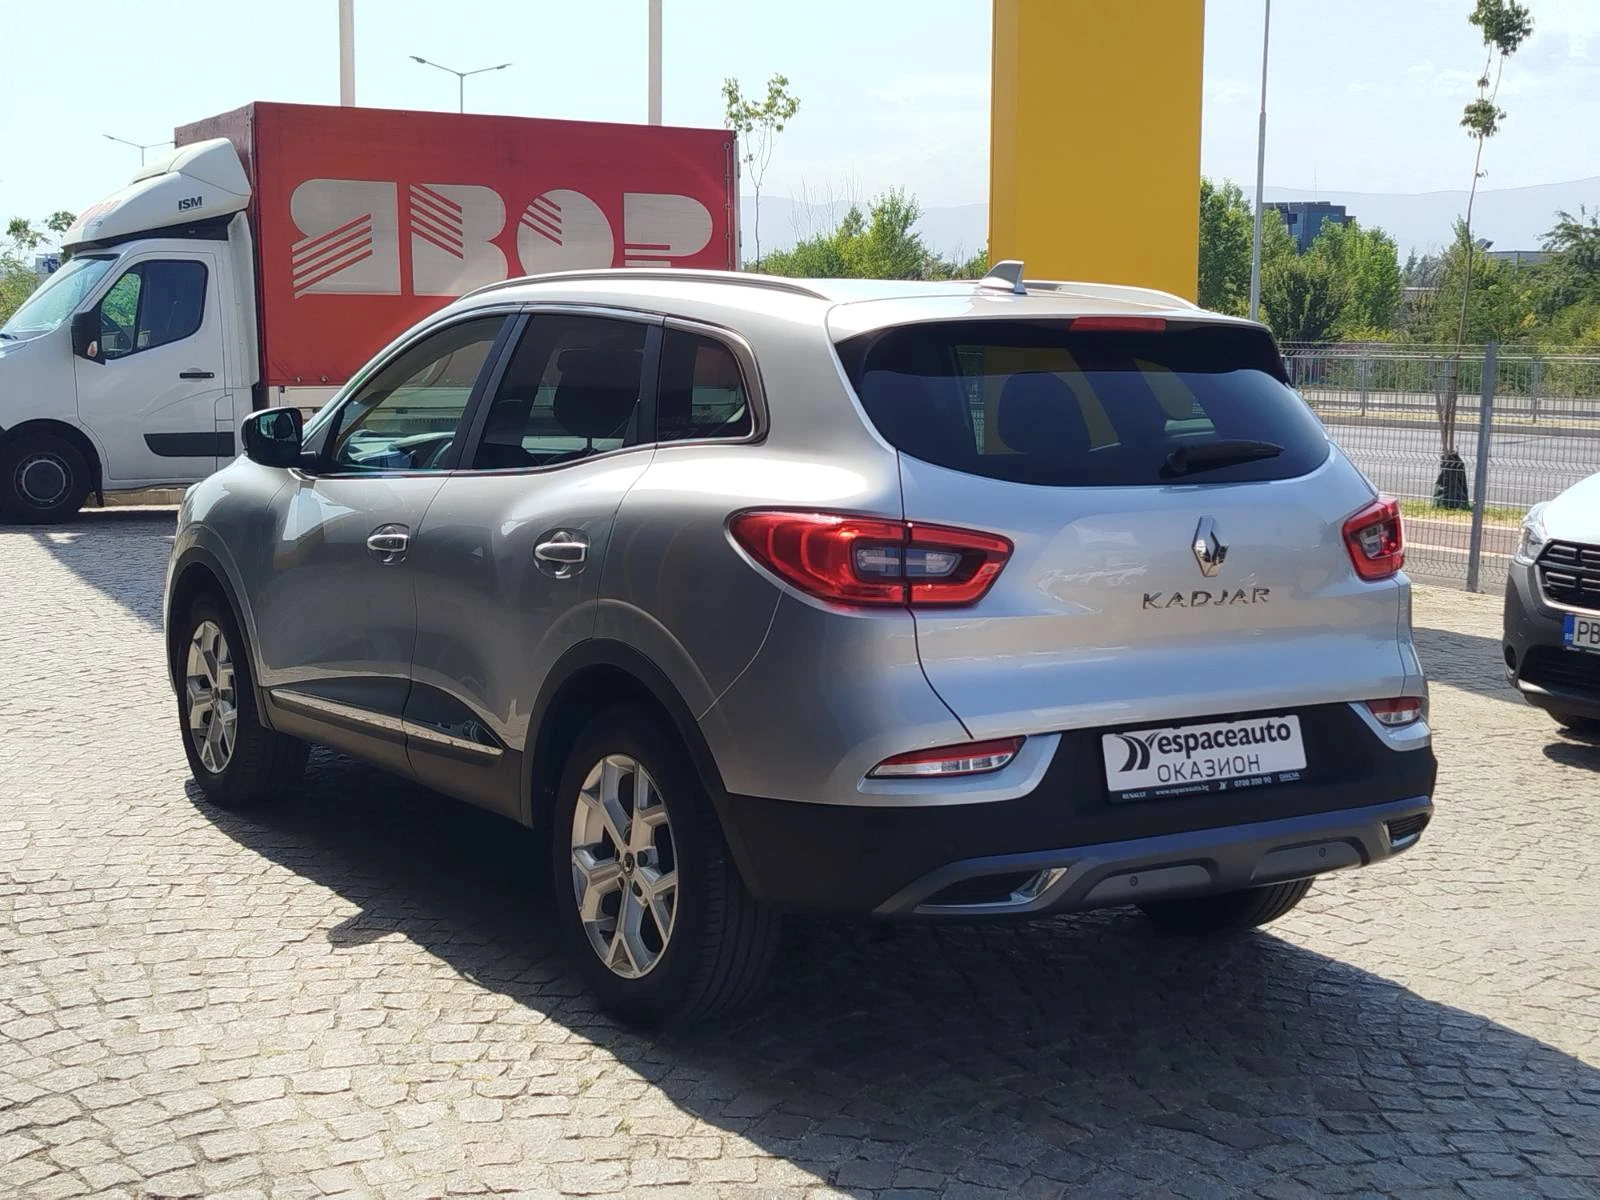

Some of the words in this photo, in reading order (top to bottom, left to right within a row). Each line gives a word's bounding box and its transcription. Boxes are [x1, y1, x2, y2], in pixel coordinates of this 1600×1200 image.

[178, 196, 203, 210] ISM
[290, 178, 714, 299] ЯВОР
[1142, 588, 1271, 610] KADJAR
[1157, 720, 1291, 759] espaceauto
[1157, 754, 1261, 783] ОКАЗИОН
